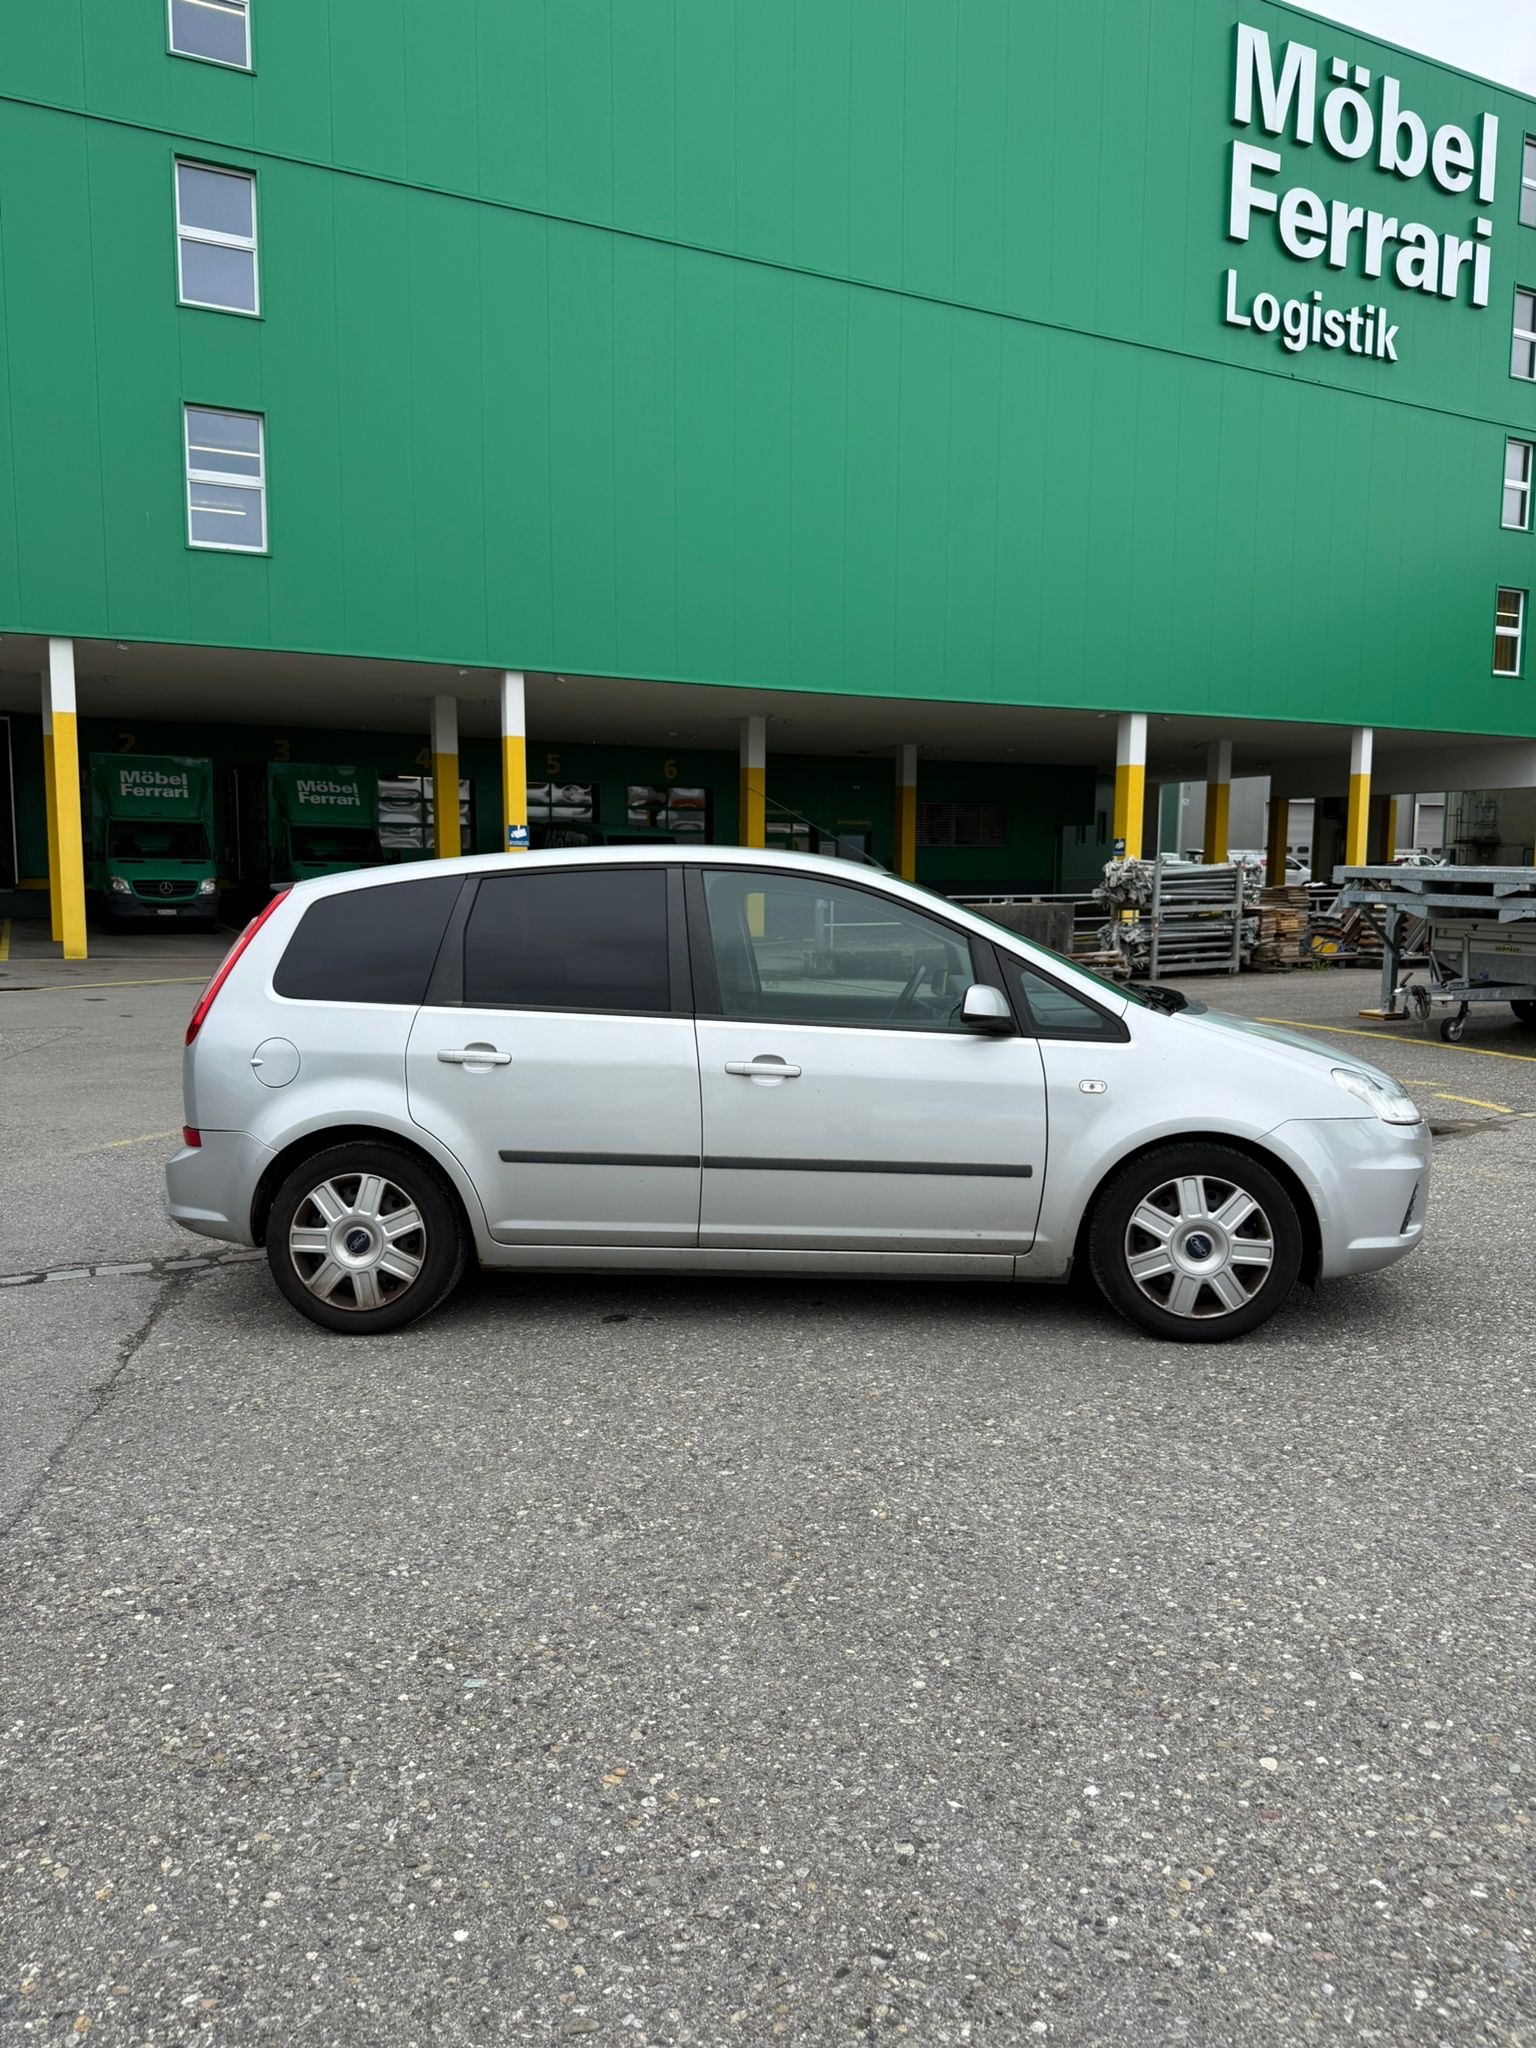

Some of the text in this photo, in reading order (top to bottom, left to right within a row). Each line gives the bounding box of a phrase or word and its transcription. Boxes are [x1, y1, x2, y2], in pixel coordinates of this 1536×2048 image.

[1230, 22, 1499, 205] Möbel
[1226, 139, 1493, 309] Ferrari
[1224, 268, 1400, 362] Logistik
[118, 733, 135, 752] 2
[274, 740, 290, 760] 3
[416, 748, 432, 768] 4
[547, 754, 561, 775] 5
[120, 771, 187, 785] Möbel
[664, 760, 677, 779] 6
[121, 785, 188, 798] Ferrari
[297, 780, 358, 794] Möbel
[300, 792, 360, 806] Ferrari
